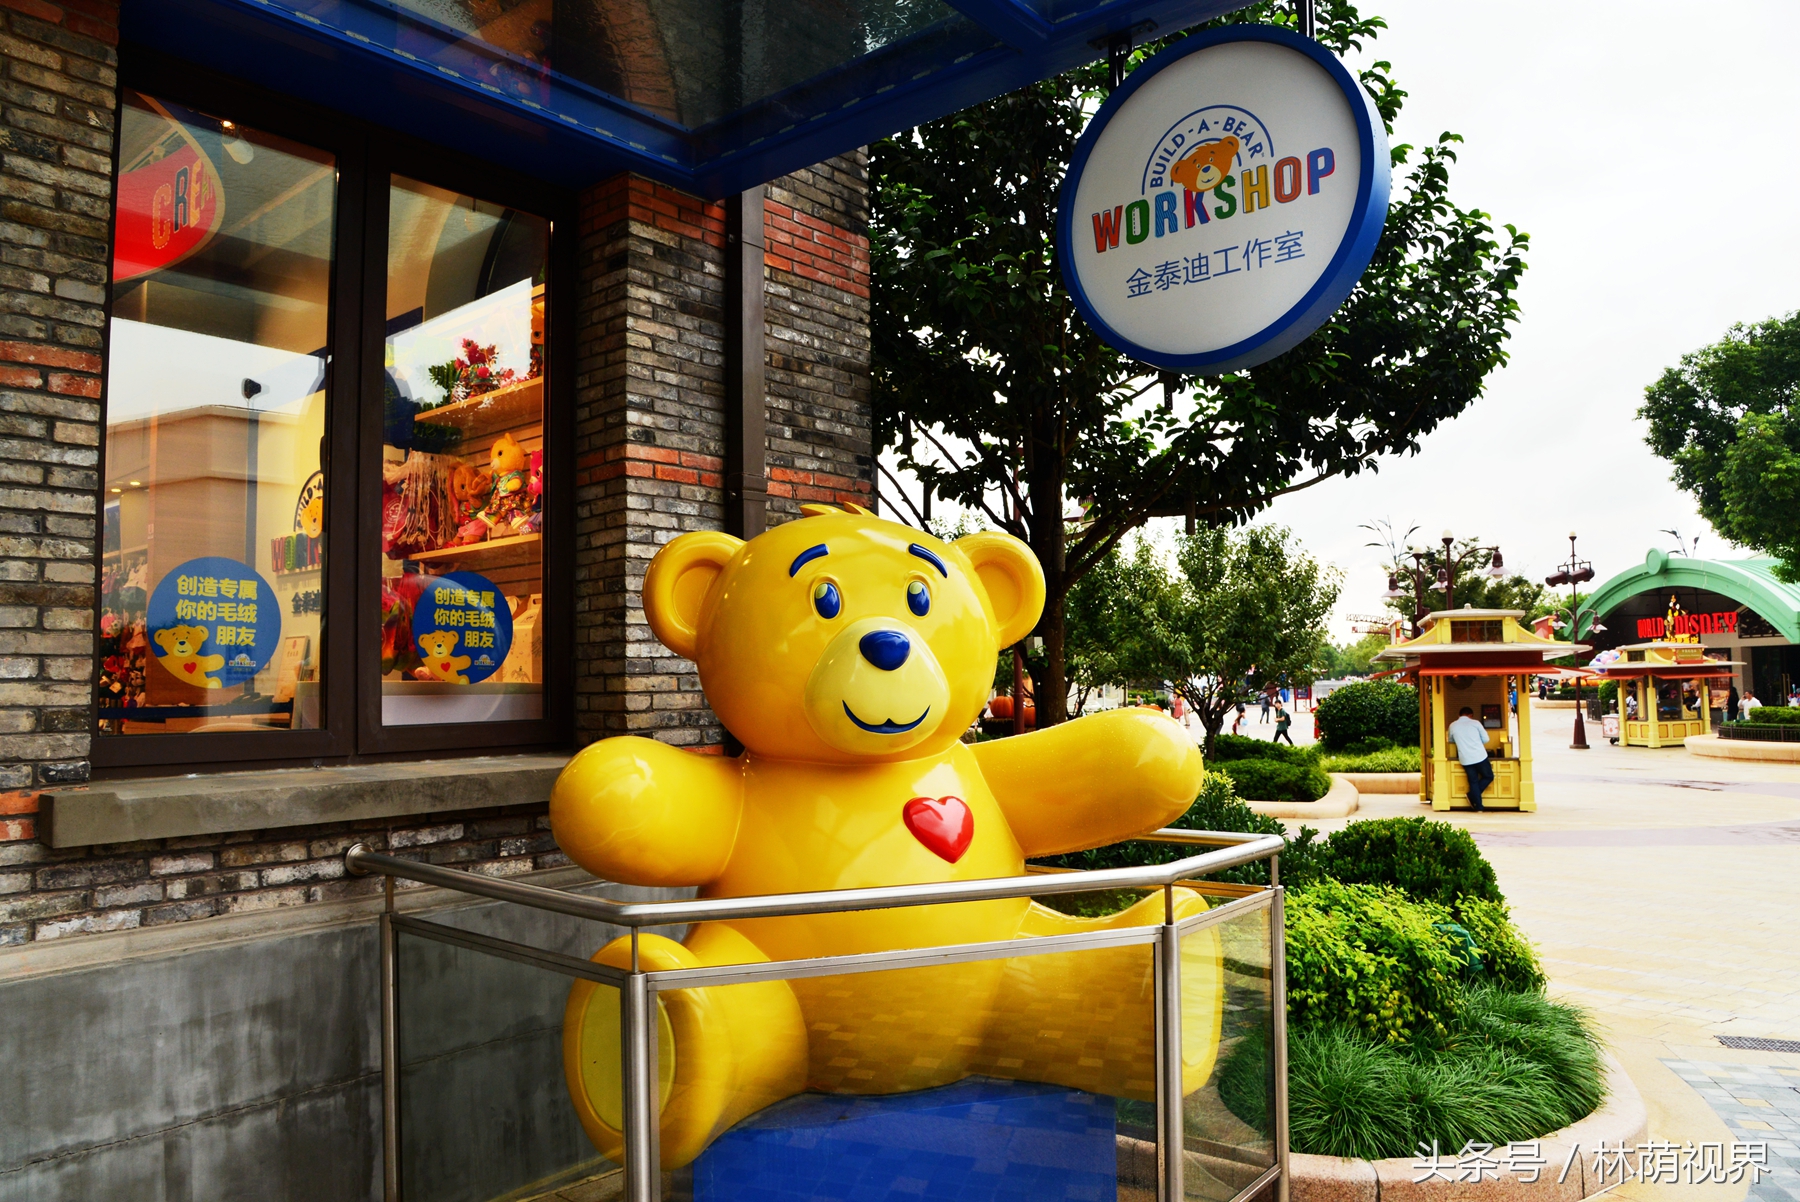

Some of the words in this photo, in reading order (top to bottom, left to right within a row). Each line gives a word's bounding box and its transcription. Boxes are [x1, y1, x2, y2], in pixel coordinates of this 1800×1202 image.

[1149, 116, 1264, 188] BUILD-A-BEAR
[1092, 148, 1335, 253] WORKSHOP
[1126, 230, 1306, 298] 金泰迪工作室
[271, 532, 322, 573] WORK
[176, 574, 258, 601] 创造专属
[434, 587, 495, 608] 创造专属
[175, 599, 258, 624] 你的毛绒
[434, 608, 495, 628] 你的毛绒
[1637, 617, 1665, 639] WORLD
[1674, 611, 1738, 635] DISNEY
[215, 626, 256, 647] 朋友
[464, 630, 495, 648] 朋友
